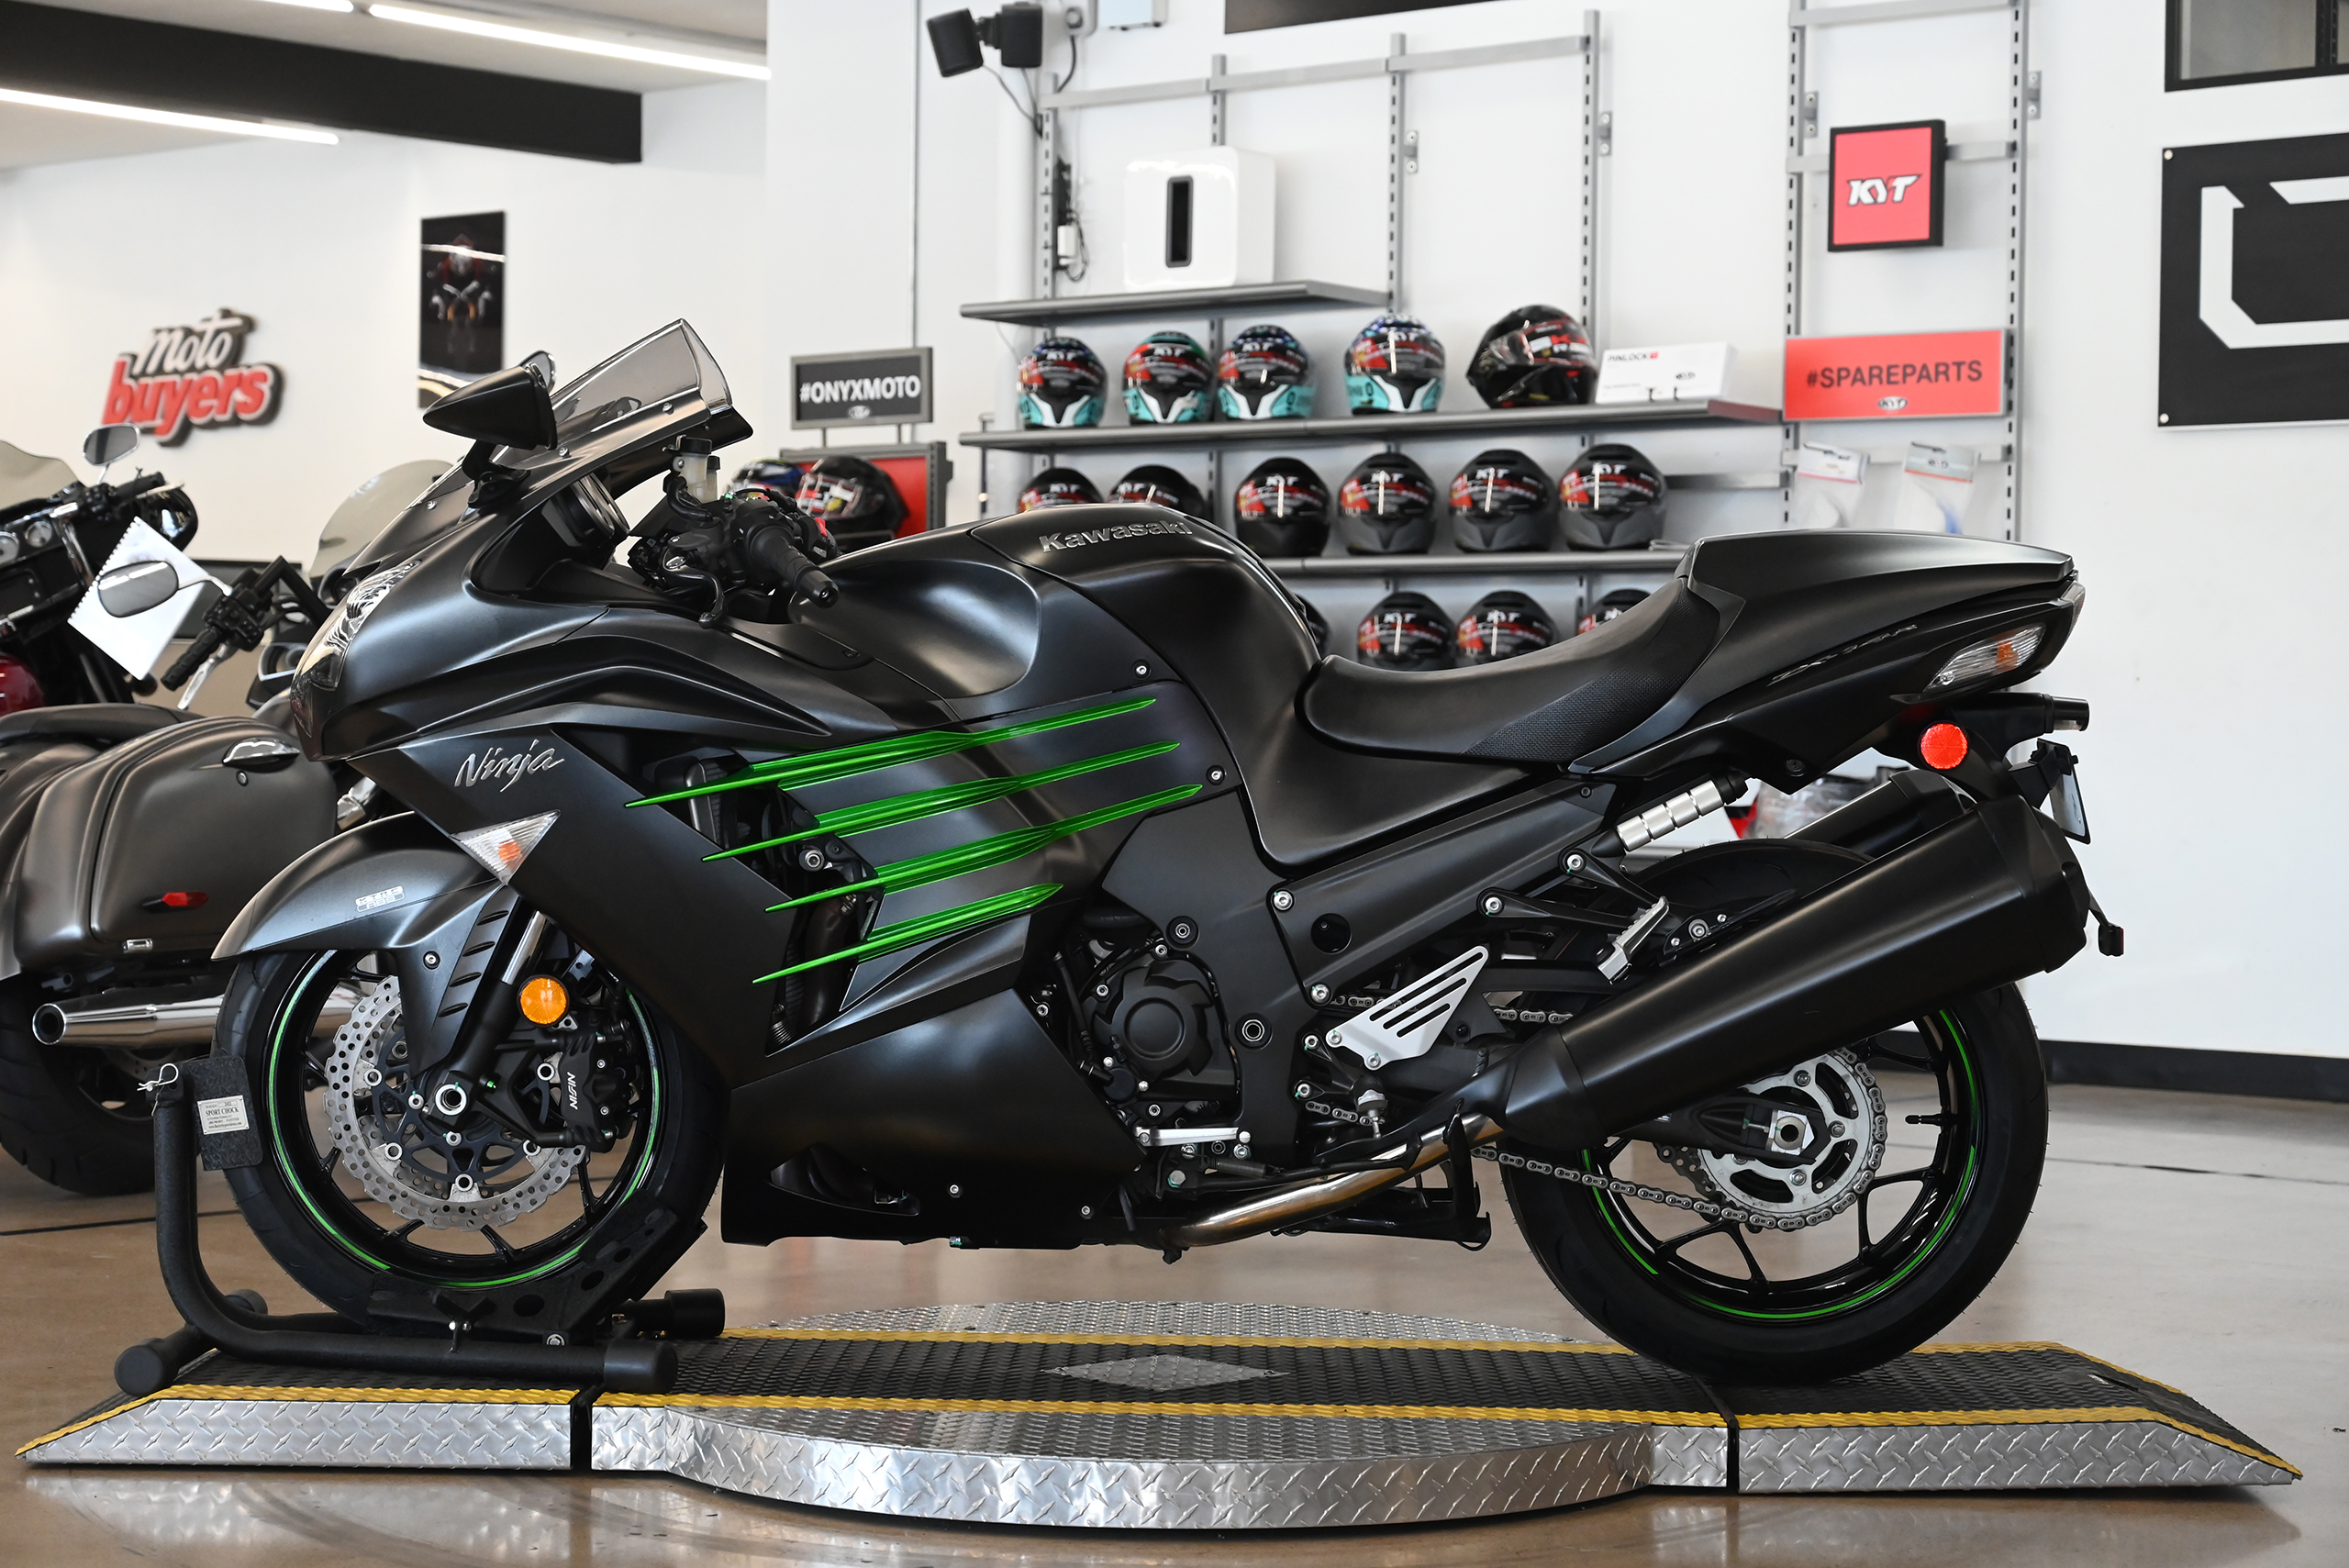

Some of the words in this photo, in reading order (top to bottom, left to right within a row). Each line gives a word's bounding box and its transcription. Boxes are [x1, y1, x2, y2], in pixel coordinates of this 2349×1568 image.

[1847, 173, 1922, 206] KYT
[799, 374, 921, 405] #ONYXMOTO
[1807, 361, 1983, 388] #SPAREPARTS
[101, 357, 273, 440] buyers
[1039, 520, 1193, 551] Kawasaki
[454, 739, 565, 793] Ninja
[221, 1106, 239, 1115] CHOCK
